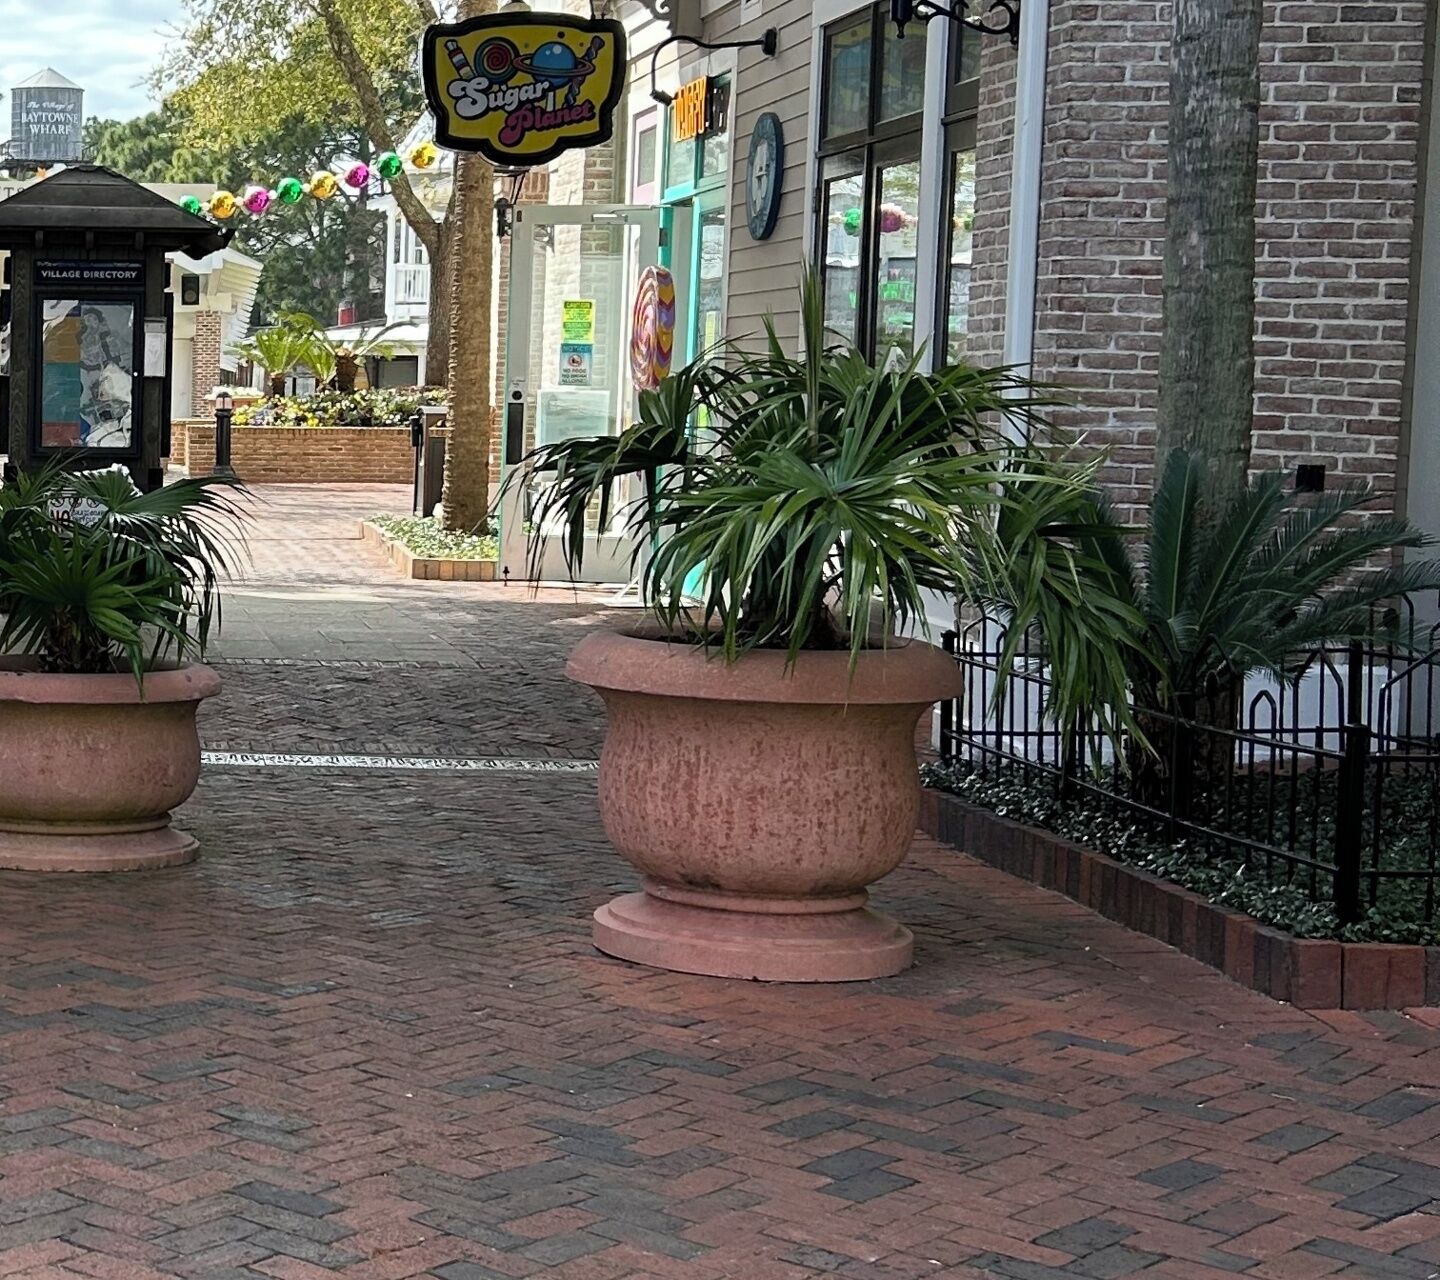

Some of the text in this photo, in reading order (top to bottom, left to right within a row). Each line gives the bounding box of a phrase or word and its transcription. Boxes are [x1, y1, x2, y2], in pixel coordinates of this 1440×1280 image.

[26, 101, 75, 111] The Village of
[21, 111, 79, 124] BAYTOWNE
[499, 99, 596, 146] Planet
[29, 124, 73, 135] WHARF
[41, 269, 138, 279] VILLAGE DIRECTORY
